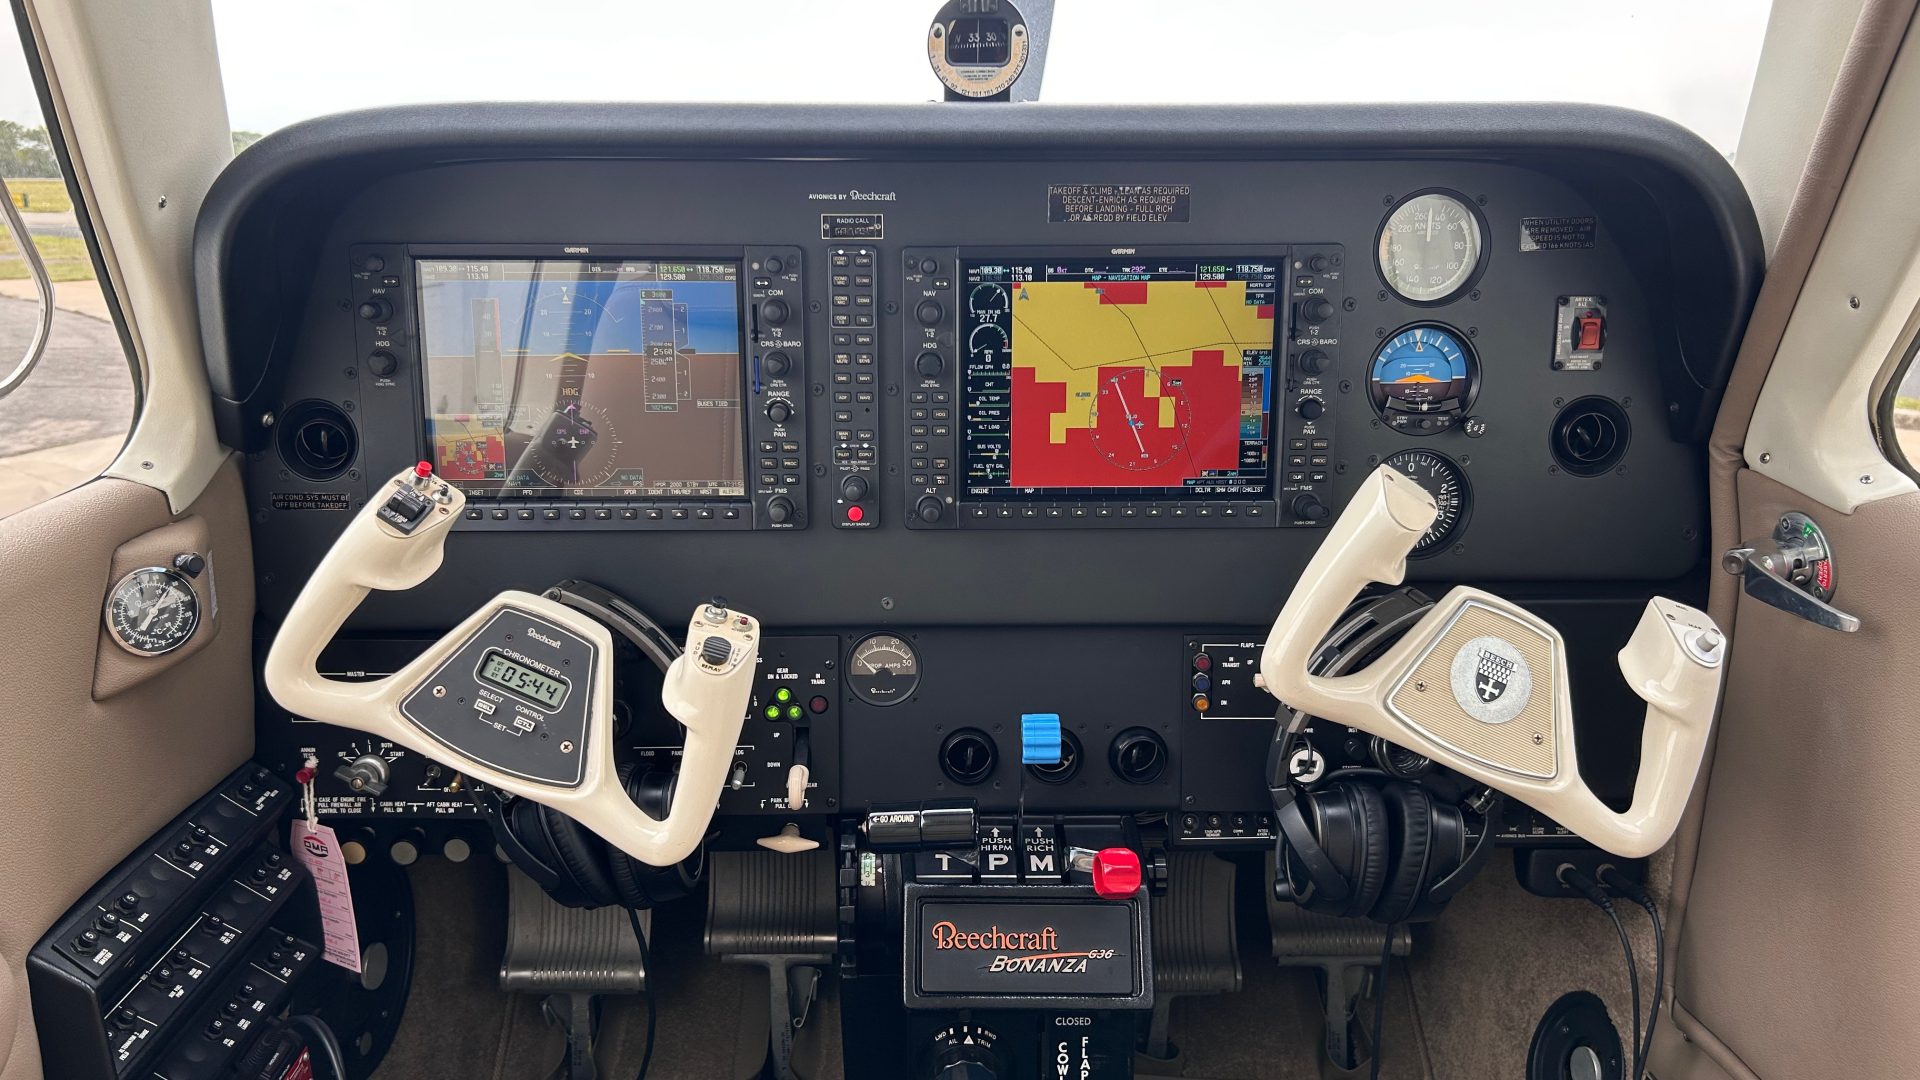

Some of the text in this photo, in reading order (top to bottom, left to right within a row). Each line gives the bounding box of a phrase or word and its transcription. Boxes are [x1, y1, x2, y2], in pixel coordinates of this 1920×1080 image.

[968, 32, 980, 42] 33
[985, 32, 997, 41] 30
[849, 189, 897, 201] Beechcraft
[1049, 186, 1081, 195] TAKEOFF
[1090, 186, 1113, 195] CLIMB
[1154, 186, 1190, 195] REQUIRED
[1062, 195, 1176, 204] DESCENT-ENRICH AS REQUIRED
[1065, 204, 1173, 213] BEFORE LANDING FULL RICH
[1070, 213, 1080, 222] OR
[1115, 213, 1125, 222] BY
[1126, 213, 1147, 222] FIELD
[1148, 213, 1168, 222] ELEV
[1398, 224, 1412, 233] 220
[1447, 222, 1458, 231] 60
[1453, 241, 1465, 250] 80
[660, 265, 724, 273] 121.650 118.750
[1011, 265, 1263, 274] 115.40 121.650 118.750
[1446, 262, 1459, 270] 100
[660, 273, 686, 281] 129.500
[1011, 274, 1033, 282] 113.10
[1429, 275, 1442, 284] 120
[979, 314, 998, 323] 27.7
[562, 387, 579, 396] HDG
[1408, 462, 1415, 472] 0
[1440, 483, 1448, 493] 2
[289, 501, 316, 509] BEFORE
[1437, 511, 1444, 520] 3
[527, 627, 562, 649] Beechcraft
[503, 648, 561, 678] CHRONOMETER
[902, 659, 912, 667] 30
[1485, 651, 1513, 669] BEECH
[701, 663, 722, 673] REPLAY
[501, 666, 558, 700] 05:44
[478, 688, 504, 704] SELECT
[515, 704, 545, 722] CONTROL
[493, 721, 507, 732] SET
[880, 814, 915, 823] GO AROUND
[935, 853, 953, 871] T
[988, 853, 1009, 871] P
[1030, 854, 1054, 872] M
[932, 920, 1058, 951] Beechcraft
[989, 949, 1115, 973] BONANZA G36
[1055, 1017, 1092, 1026] CLOSED
[934, 1031, 947, 1041] LWD
[984, 1029, 997, 1040] RWD
[948, 1038, 959, 1046] AIL
[977, 1038, 991, 1048] TRIM
